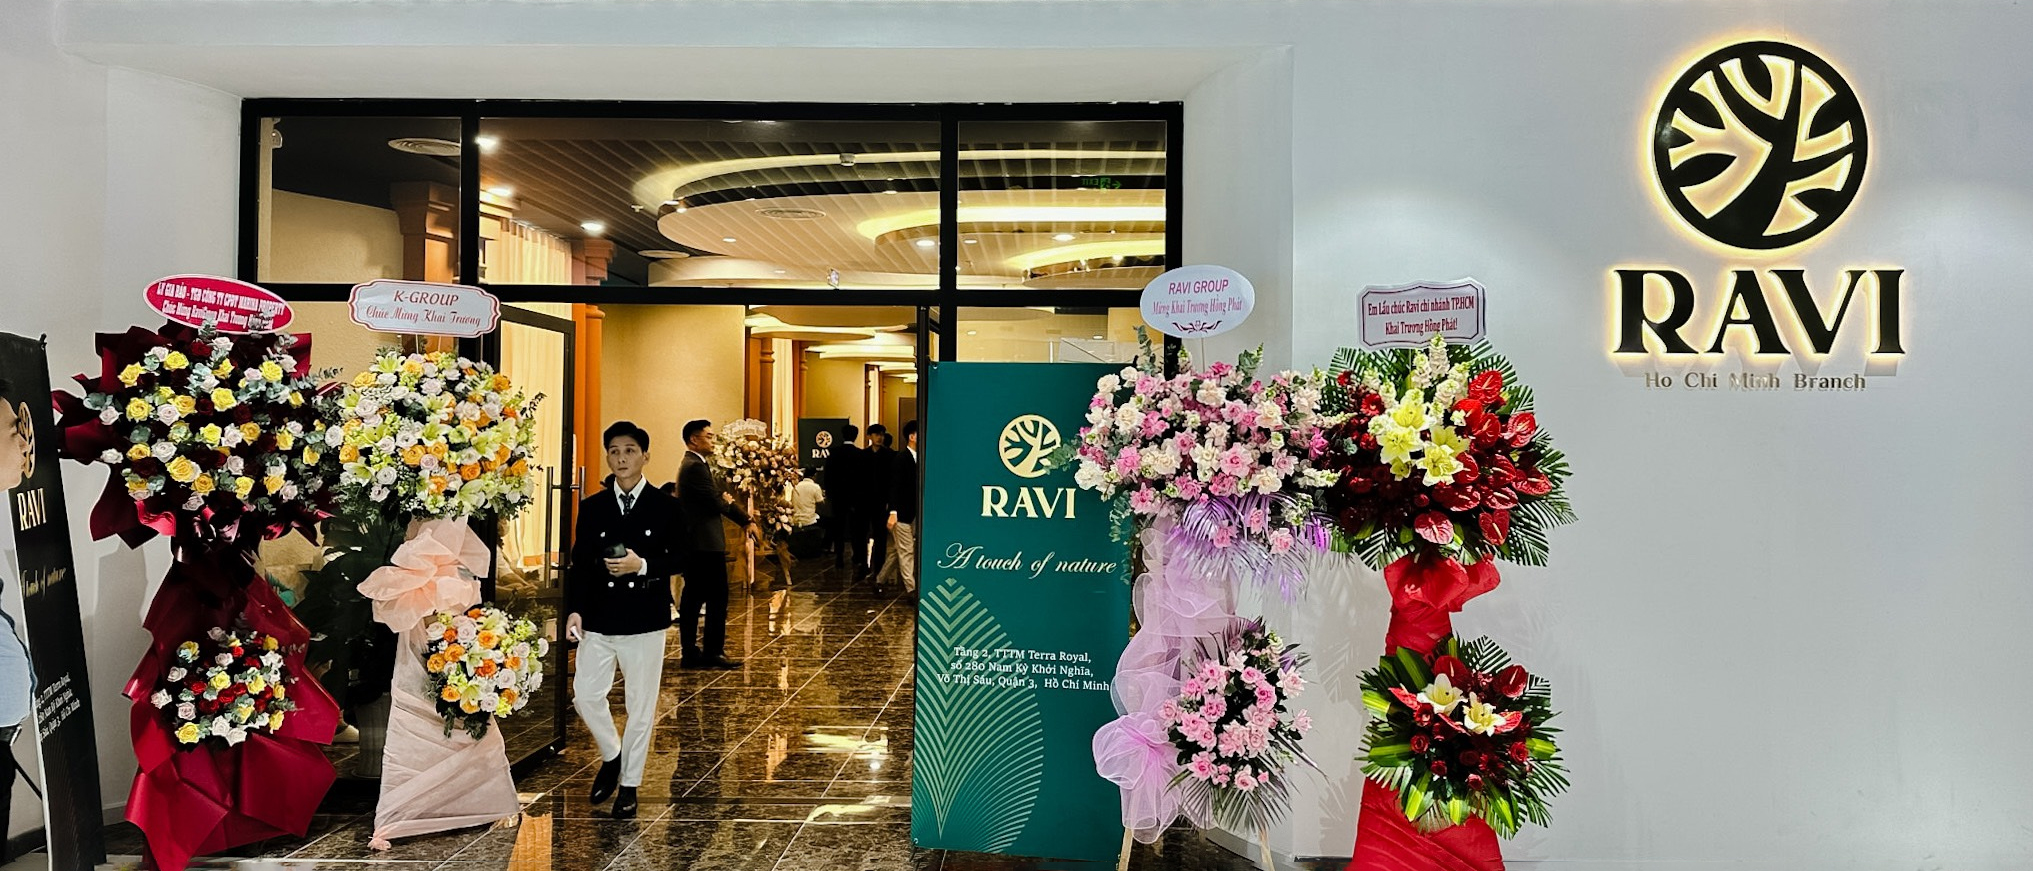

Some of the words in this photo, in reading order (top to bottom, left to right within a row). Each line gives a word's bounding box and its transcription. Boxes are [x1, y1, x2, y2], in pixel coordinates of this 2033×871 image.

[1168, 282, 1191, 295] RAVI
[1194, 280, 1229, 294] GROUP
[394, 290, 459, 306] K-GROUP
[1368, 303, 1377, 315] Em
[1406, 300, 1419, 313] Ravi
[1613, 269, 1906, 354] RAVI
[424, 309, 446, 322] Khai
[1385, 322, 1400, 335] Khai
[1645, 372, 1672, 388] Ho
[1684, 372, 1718, 388] Chi
[1728, 372, 1780, 389] Minh
[1794, 373, 1866, 389] Branch
[812, 449, 830, 458] RAV
[17, 488, 47, 531] RAVI
[981, 485, 1076, 519] RAVI
[937, 542, 984, 569] A
[976, 551, 1023, 571] touch
[1028, 552, 1055, 580] of
[1055, 558, 1118, 574] nature
[982, 649, 991, 658] 2,
[994, 648, 1025, 659] TTTM
[1028, 650, 1056, 660] Terra
[1059, 652, 1092, 663] Royal,
[965, 661, 985, 670] 280
[988, 662, 1012, 672] Nam
[1028, 679, 1038, 688] 3,
[1044, 677, 1059, 688] Hồ
[1062, 678, 1080, 689] Chí
[1083, 681, 1110, 691] Minh
